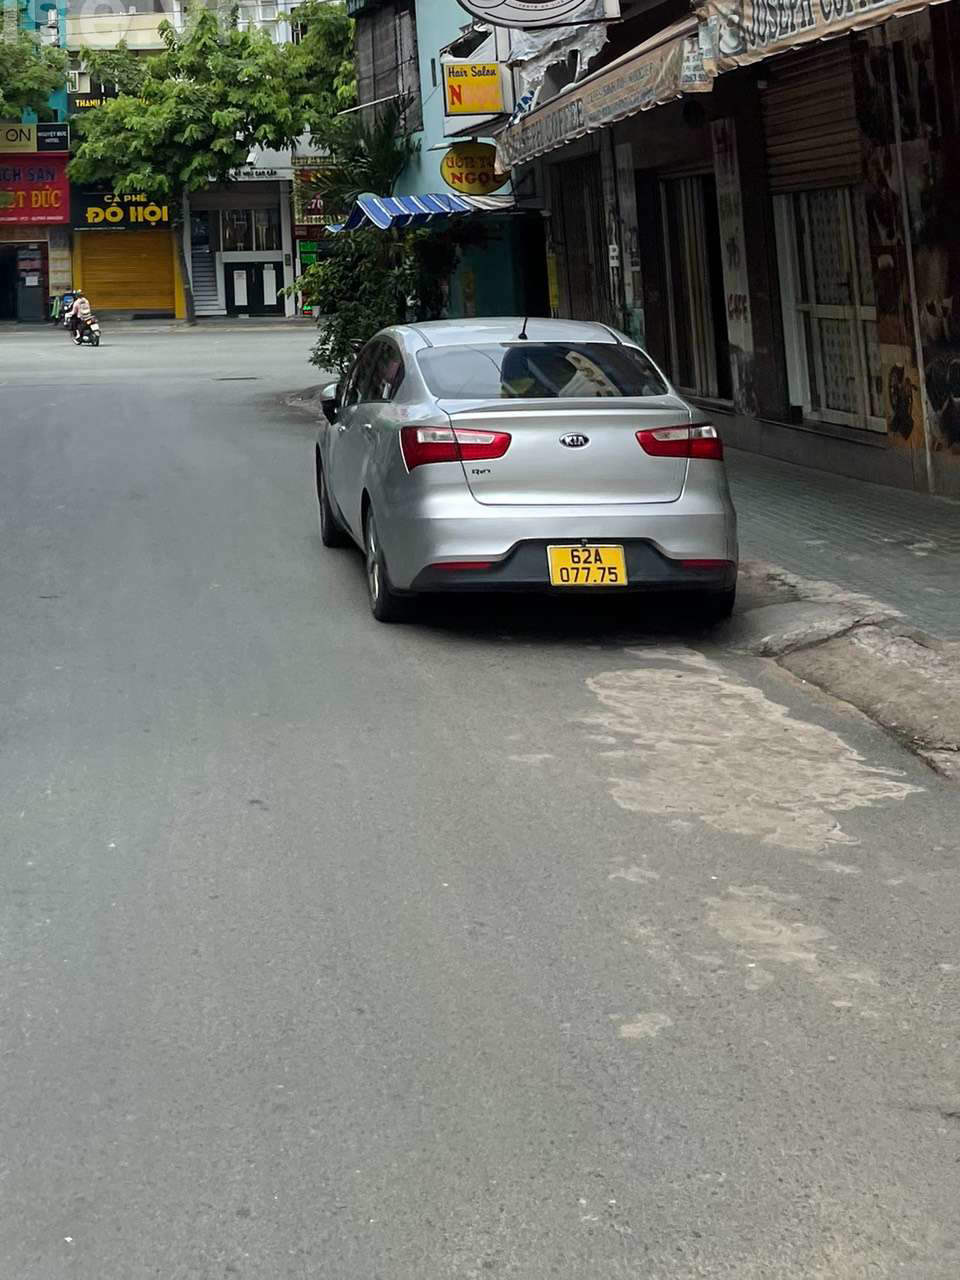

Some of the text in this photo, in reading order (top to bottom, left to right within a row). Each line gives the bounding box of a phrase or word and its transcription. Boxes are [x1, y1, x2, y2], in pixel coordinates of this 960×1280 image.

[448, 66, 497, 78] Hair Salon
[5, 127, 32, 142] ON
[31, 184, 62, 208] ĐỨC
[564, 435, 585, 446] KIA
[570, 548, 603, 564] 62A
[559, 566, 619, 583] 077.75
